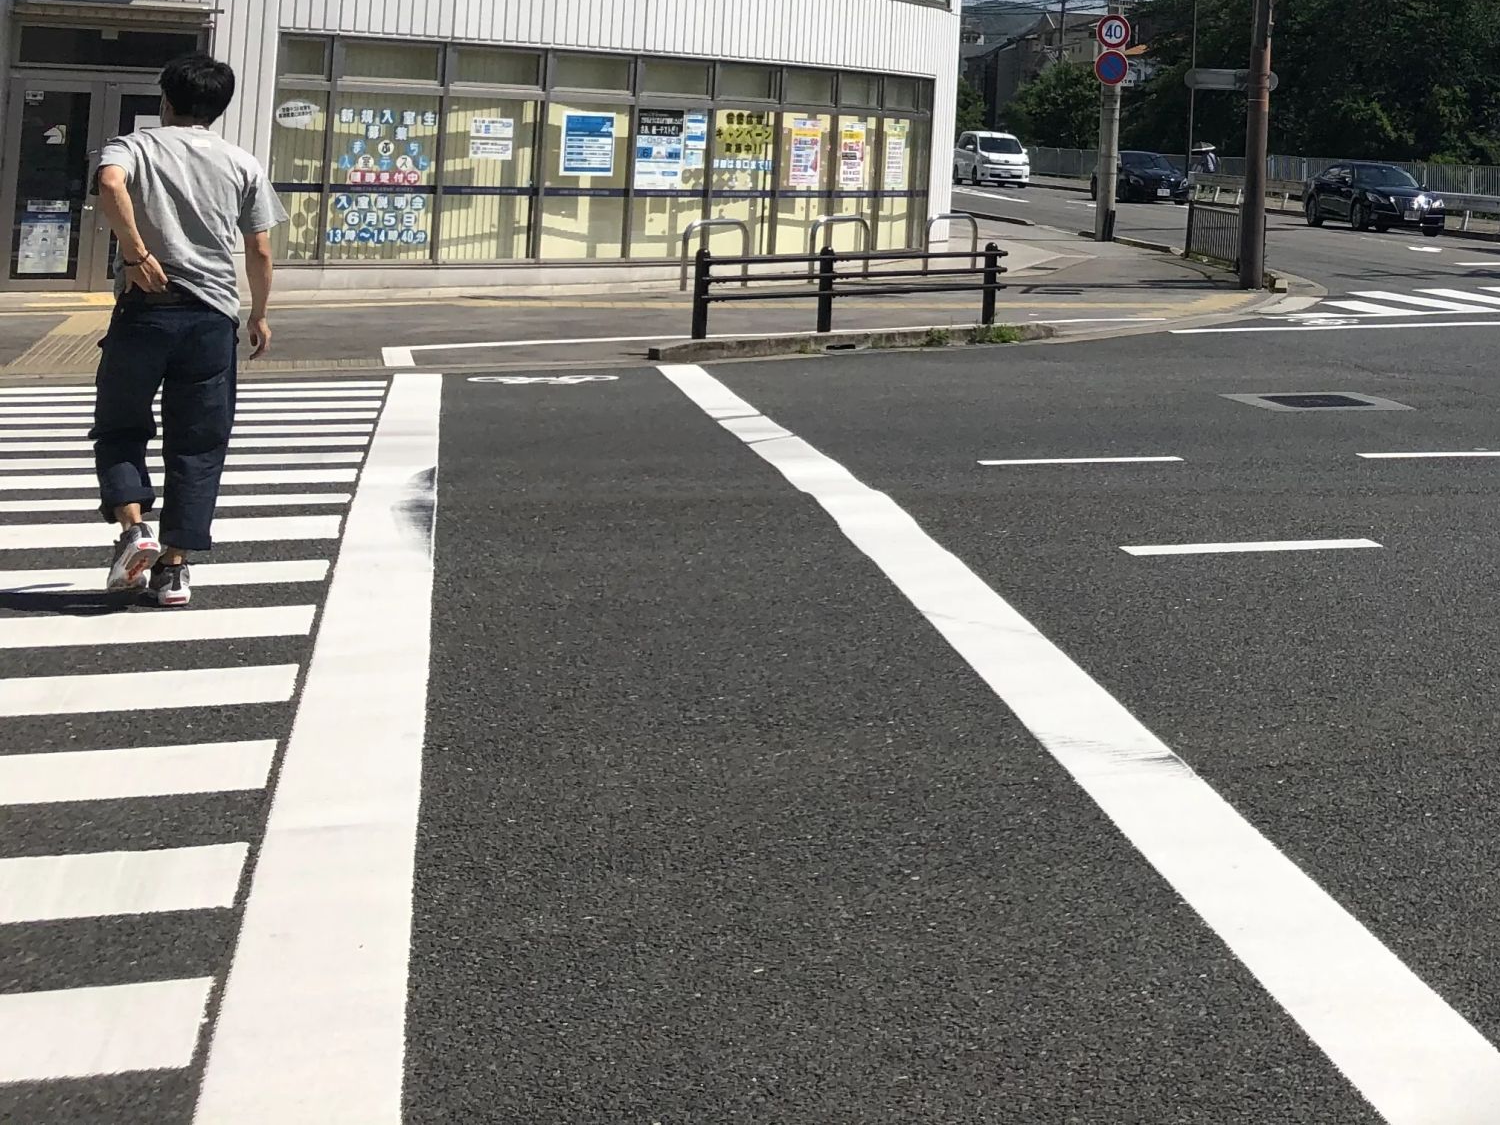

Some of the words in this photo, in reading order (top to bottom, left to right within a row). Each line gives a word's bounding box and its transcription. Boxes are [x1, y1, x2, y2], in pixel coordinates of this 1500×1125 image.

[1104, 24, 1123, 40] 40
[341, 108, 436, 126] 新規入室生
[716, 127, 772, 140] キャンペーン
[341, 154, 429, 170] 入室テスト
[336, 195, 425, 210] 入室説明会
[345, 212, 416, 226] 6月5日
